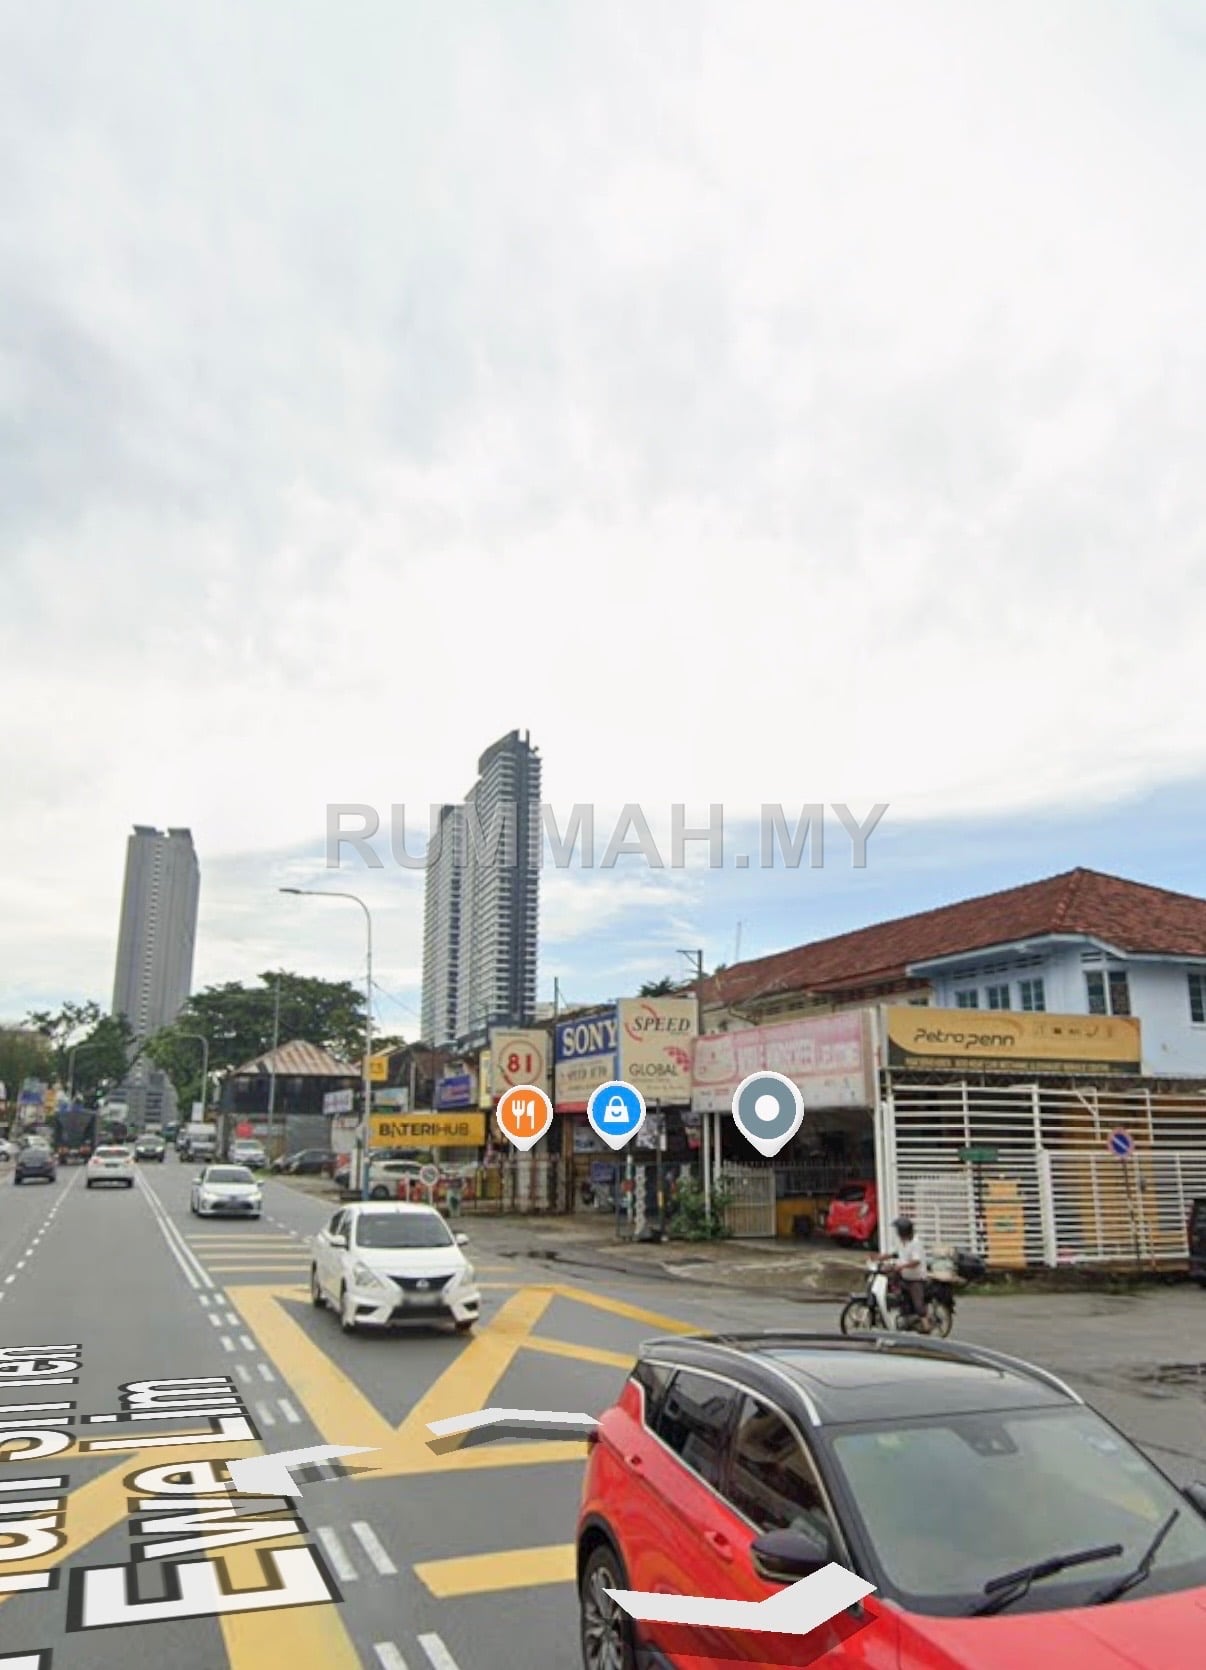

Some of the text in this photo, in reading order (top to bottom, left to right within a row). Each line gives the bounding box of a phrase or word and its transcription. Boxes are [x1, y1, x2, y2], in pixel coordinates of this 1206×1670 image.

[632, 1015, 692, 1033] SPEED
[562, 1018, 618, 1057] SONY
[507, 1052, 533, 1074] 81
[628, 1062, 678, 1077] GLOBAL
